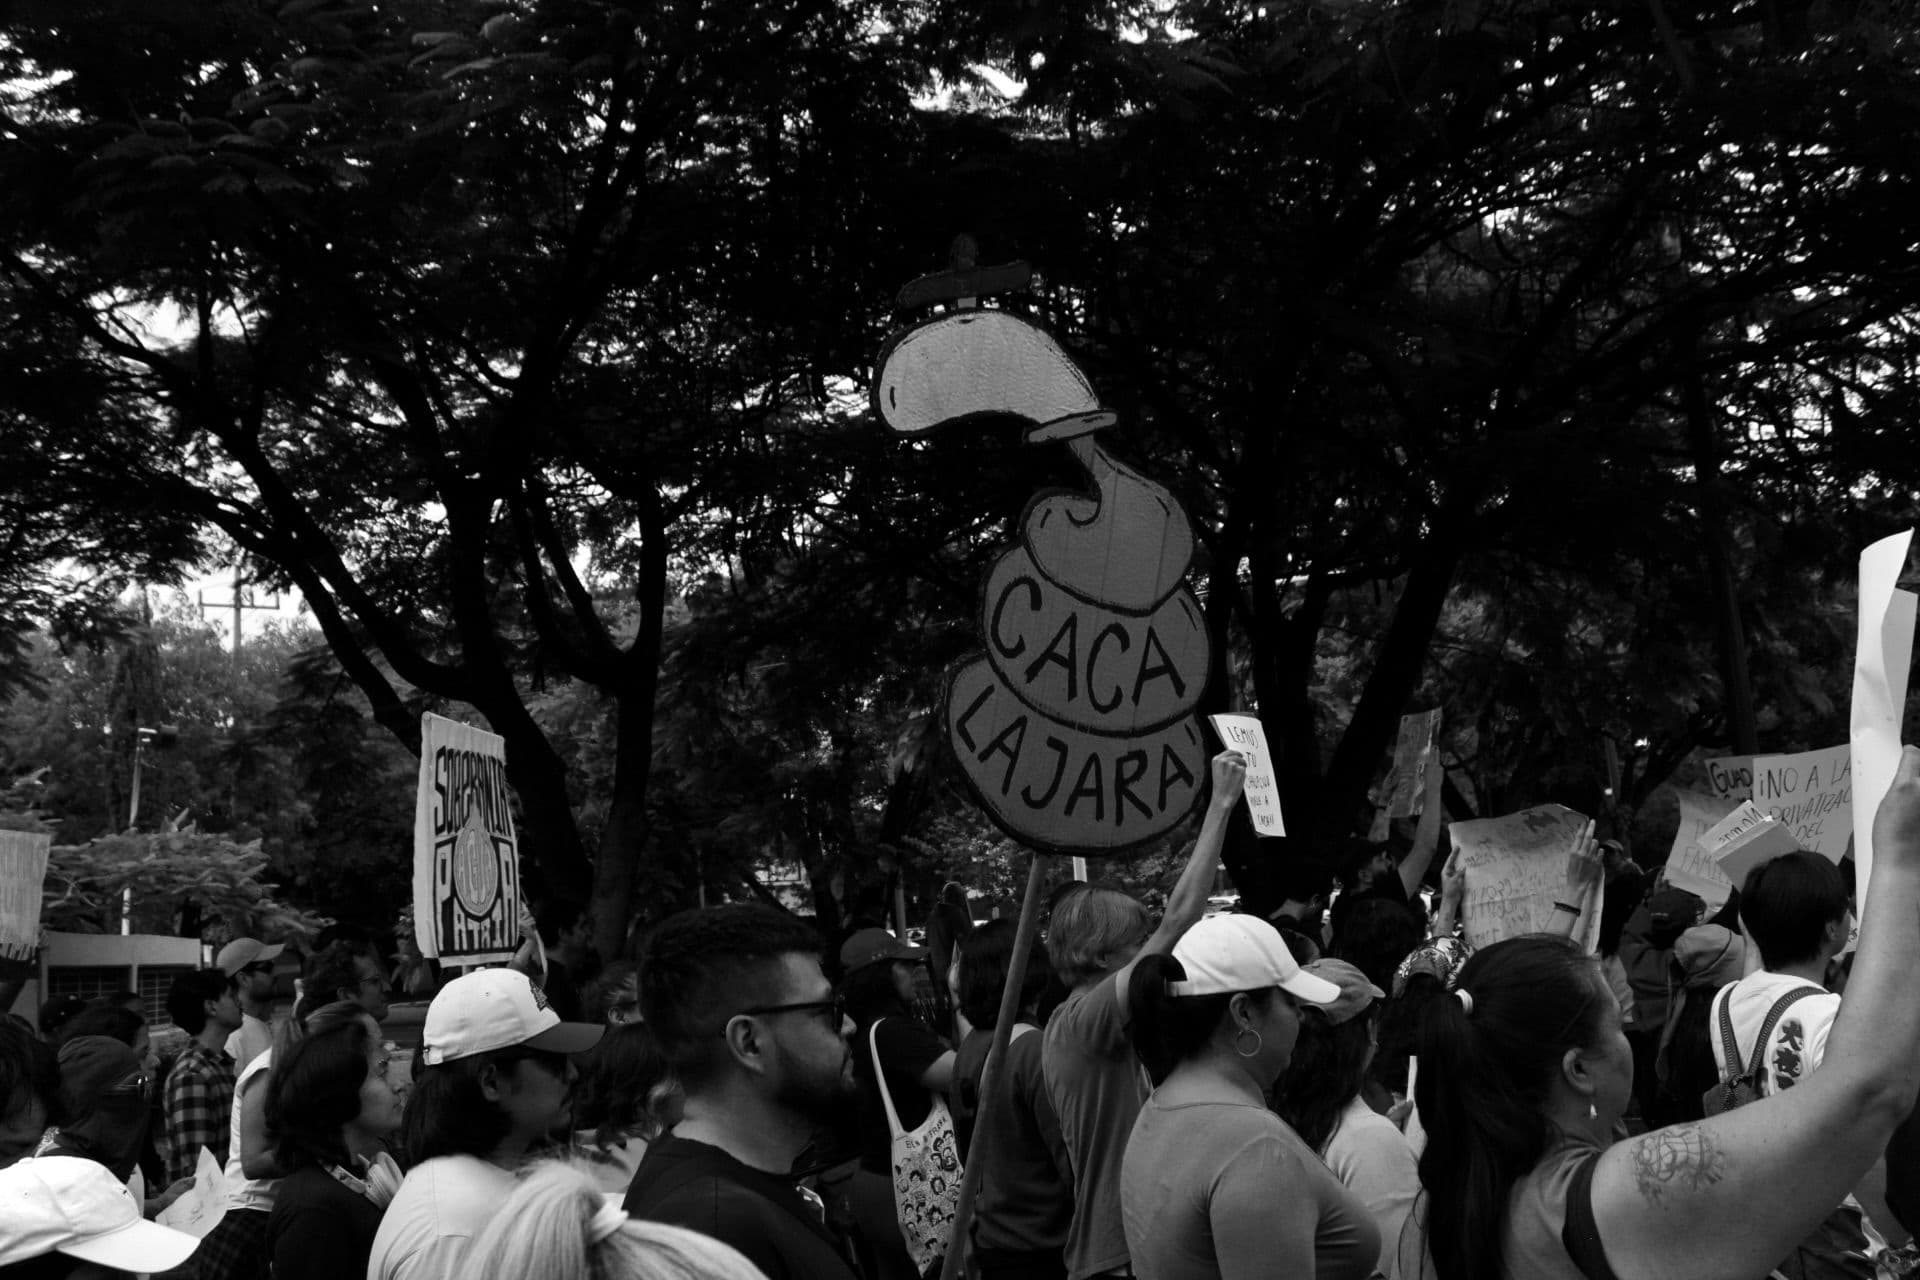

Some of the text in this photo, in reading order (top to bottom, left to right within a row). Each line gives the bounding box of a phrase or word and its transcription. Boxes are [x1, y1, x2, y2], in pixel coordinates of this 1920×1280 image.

[991, 576, 1186, 713] CACA
[956, 684, 1194, 826] LAJARA
[1760, 767, 1799, 799] ¡NO
[1805, 765, 1819, 793] A
[435, 842, 518, 952] PATRIA
